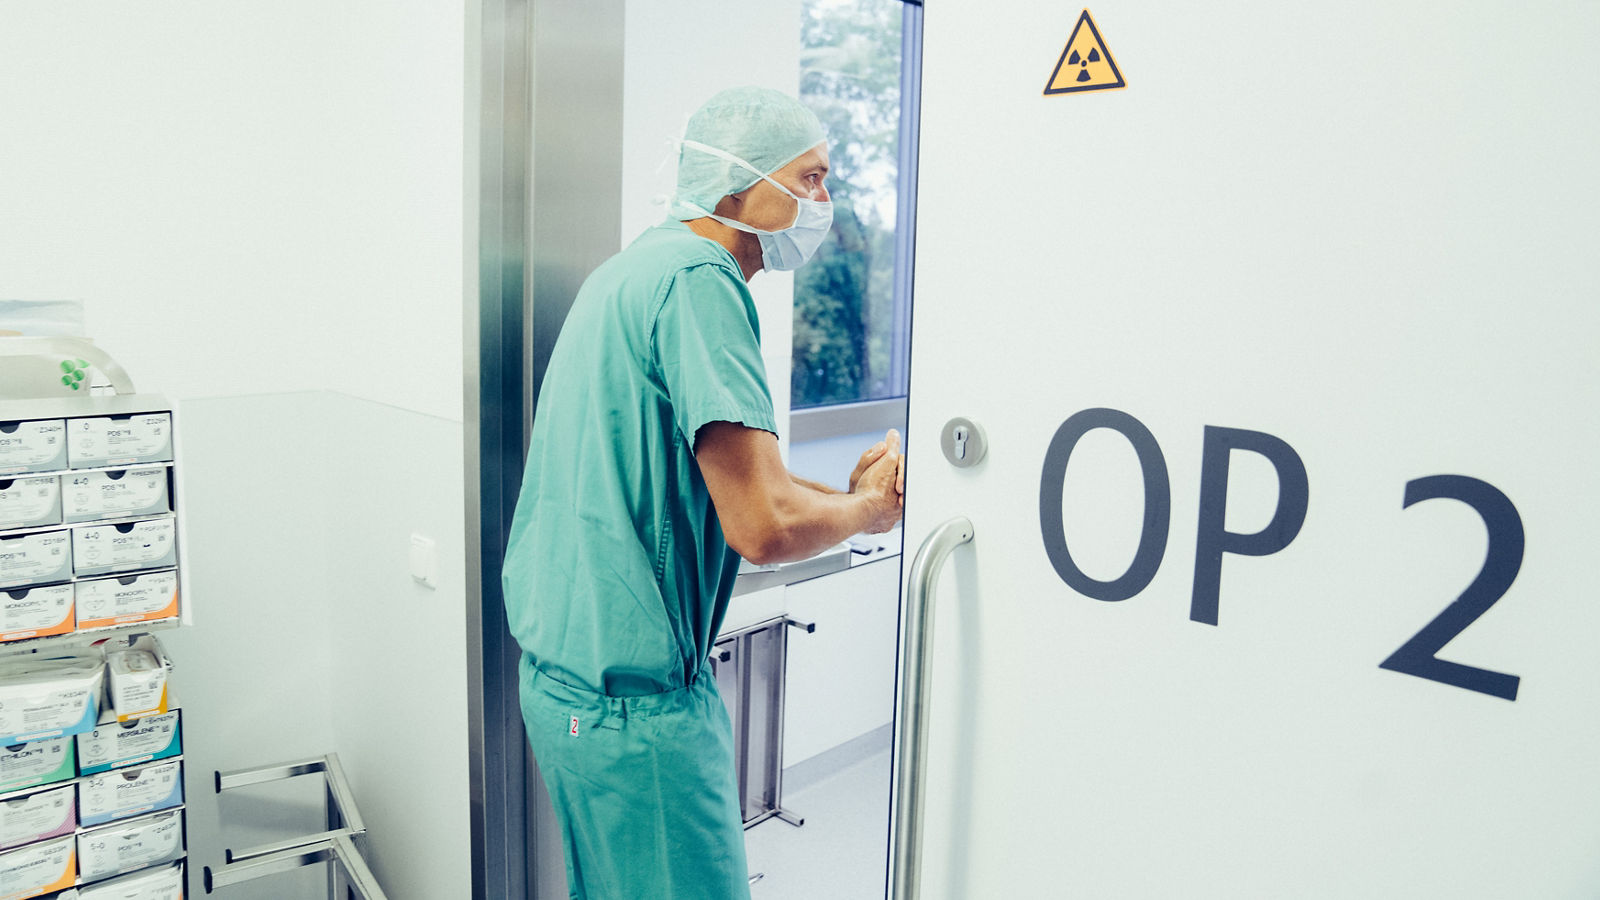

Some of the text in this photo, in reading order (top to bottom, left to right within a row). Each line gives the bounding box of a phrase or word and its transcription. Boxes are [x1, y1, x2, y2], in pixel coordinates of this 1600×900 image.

[73, 477, 89, 486] 4-0
[84, 531, 100, 540] 4-0
[1039, 408, 1525, 701] OP 2
[571, 718, 578, 734] 2
